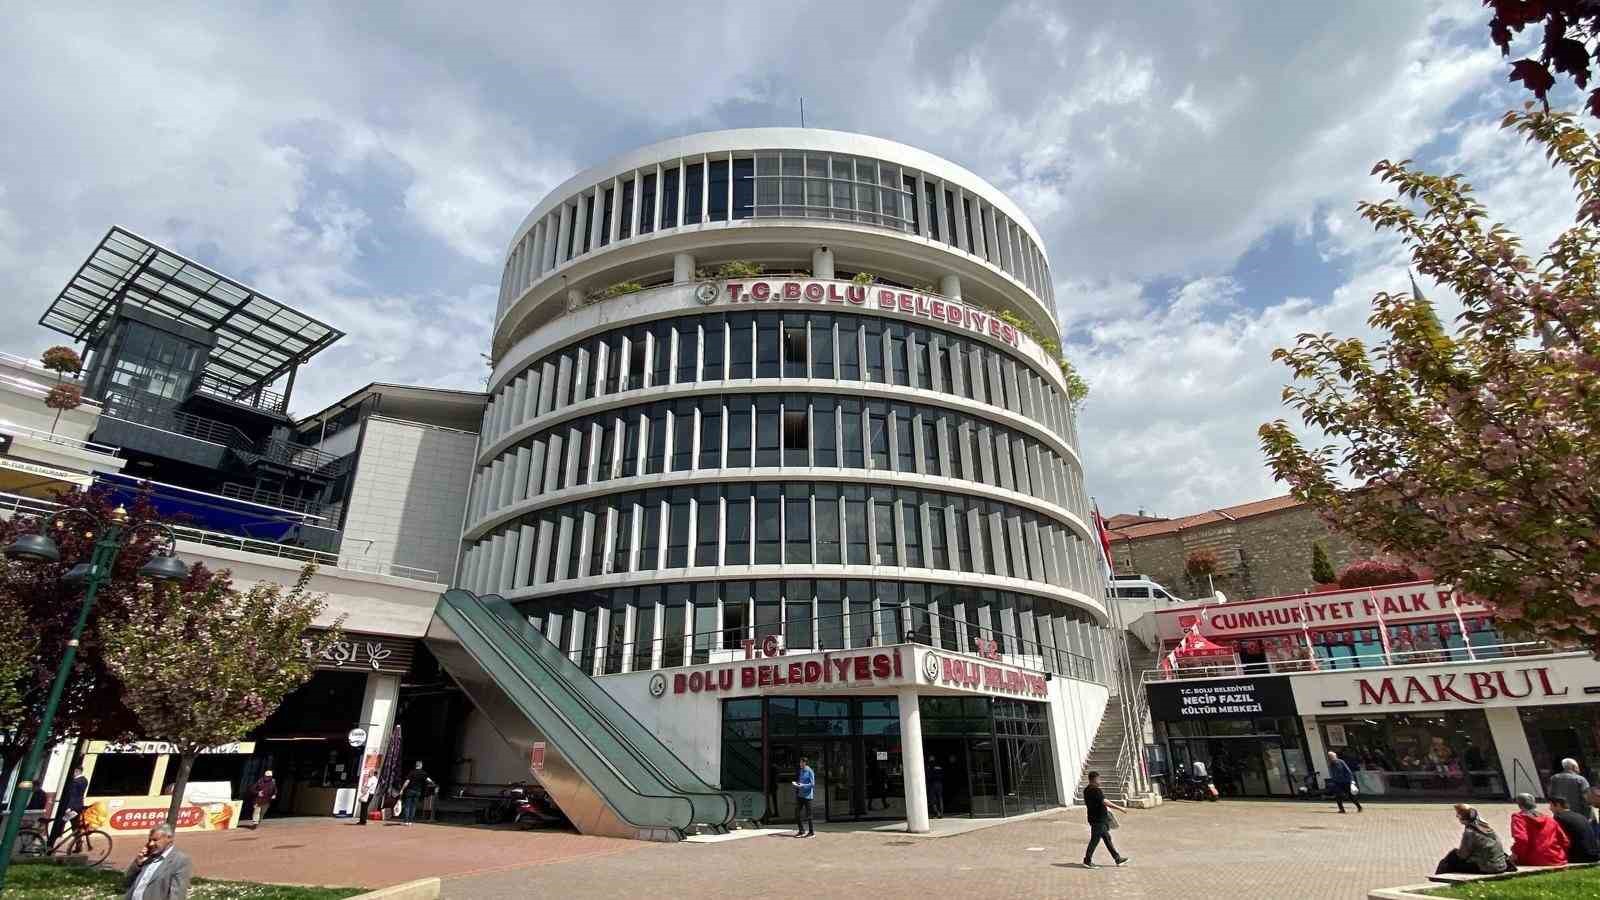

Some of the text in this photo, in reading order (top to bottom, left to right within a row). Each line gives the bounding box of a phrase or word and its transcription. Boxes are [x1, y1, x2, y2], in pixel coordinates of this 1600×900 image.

[1211, 601, 1354, 630] CUMHURİYET
[1363, 592, 1430, 616] HALK
[741, 635, 785, 660] T.C.
[673, 648, 903, 694] BOLU BELEDİYESİ
[942, 657, 980, 688] BOLU
[1183, 693, 1254, 705] NECİP FAZIL
[1214, 684, 1255, 693] BELEDİYESİ
[1354, 667, 1568, 705] MAKBUL
[1181, 703, 1262, 715] KÜLTÜR MERKEZİ
